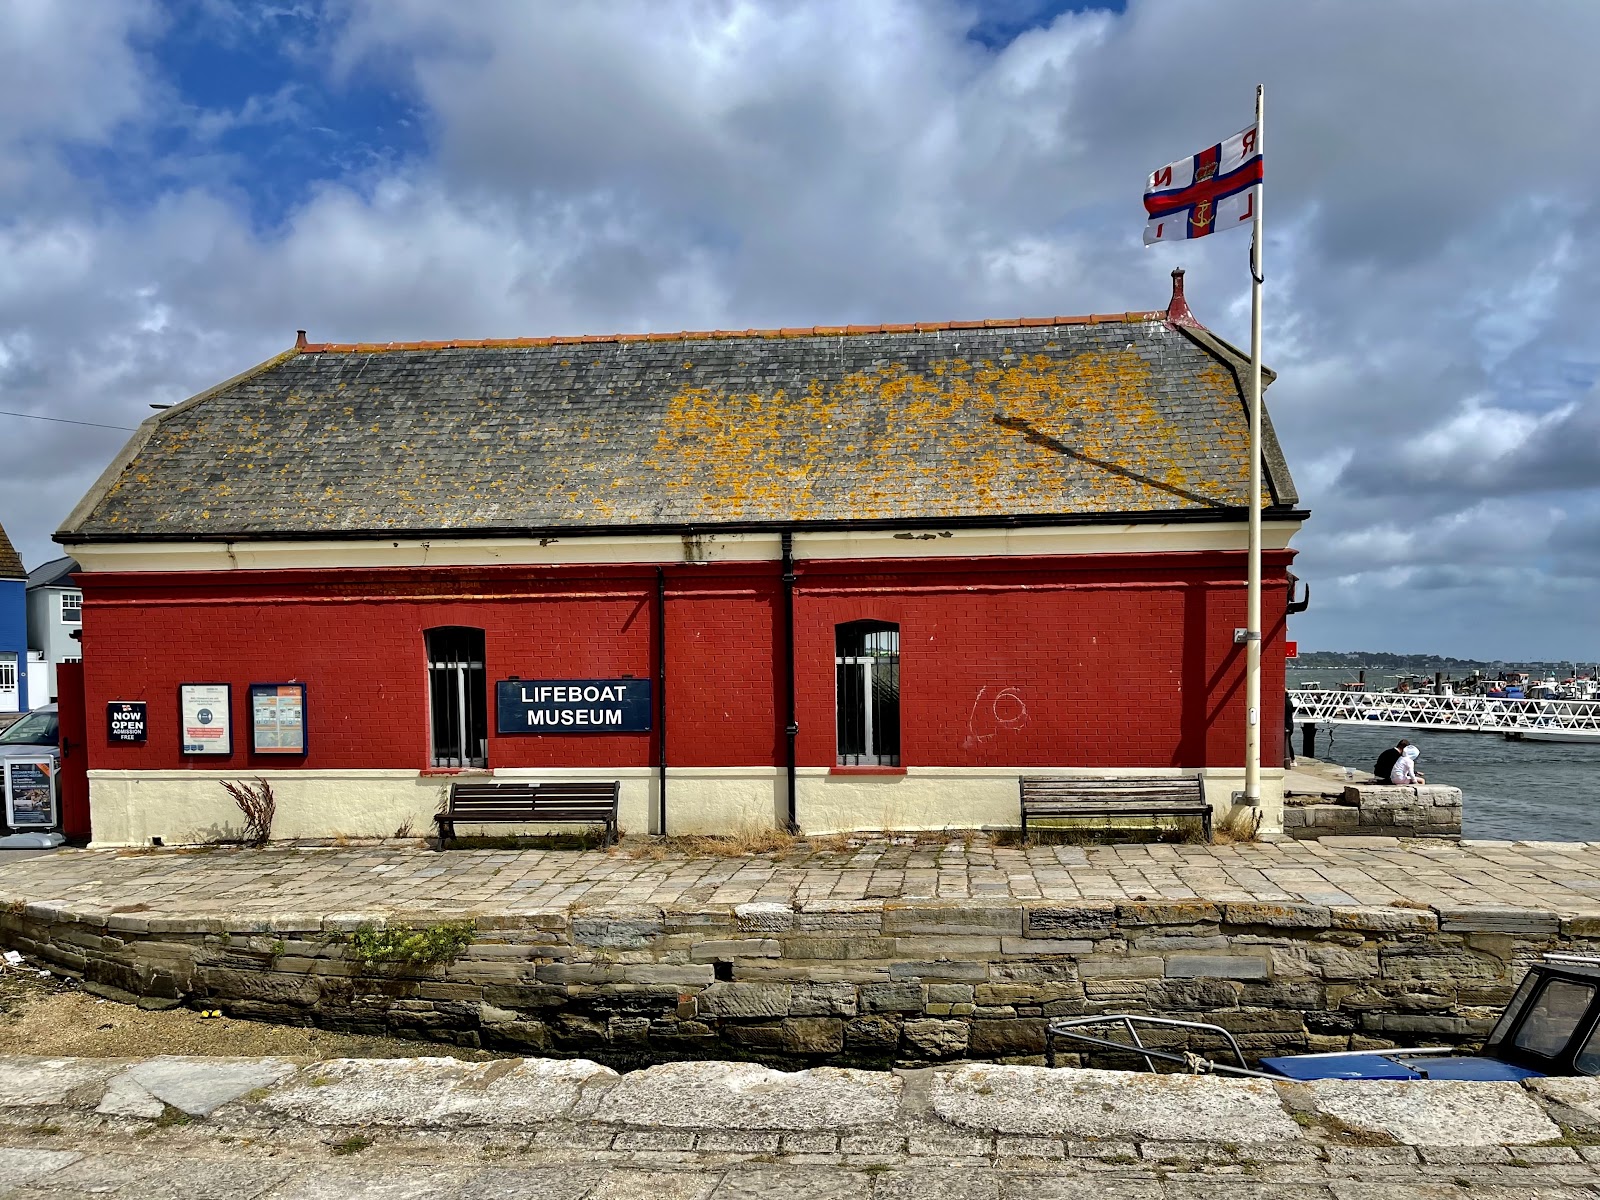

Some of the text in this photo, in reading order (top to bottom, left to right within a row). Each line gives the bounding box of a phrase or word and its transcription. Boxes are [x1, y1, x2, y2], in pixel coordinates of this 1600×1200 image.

[521, 686, 627, 703] LIFEBOAT
[113, 712, 141, 720] NOW
[527, 709, 622, 726] MUSEUM
[111, 721, 144, 729] OPEN
